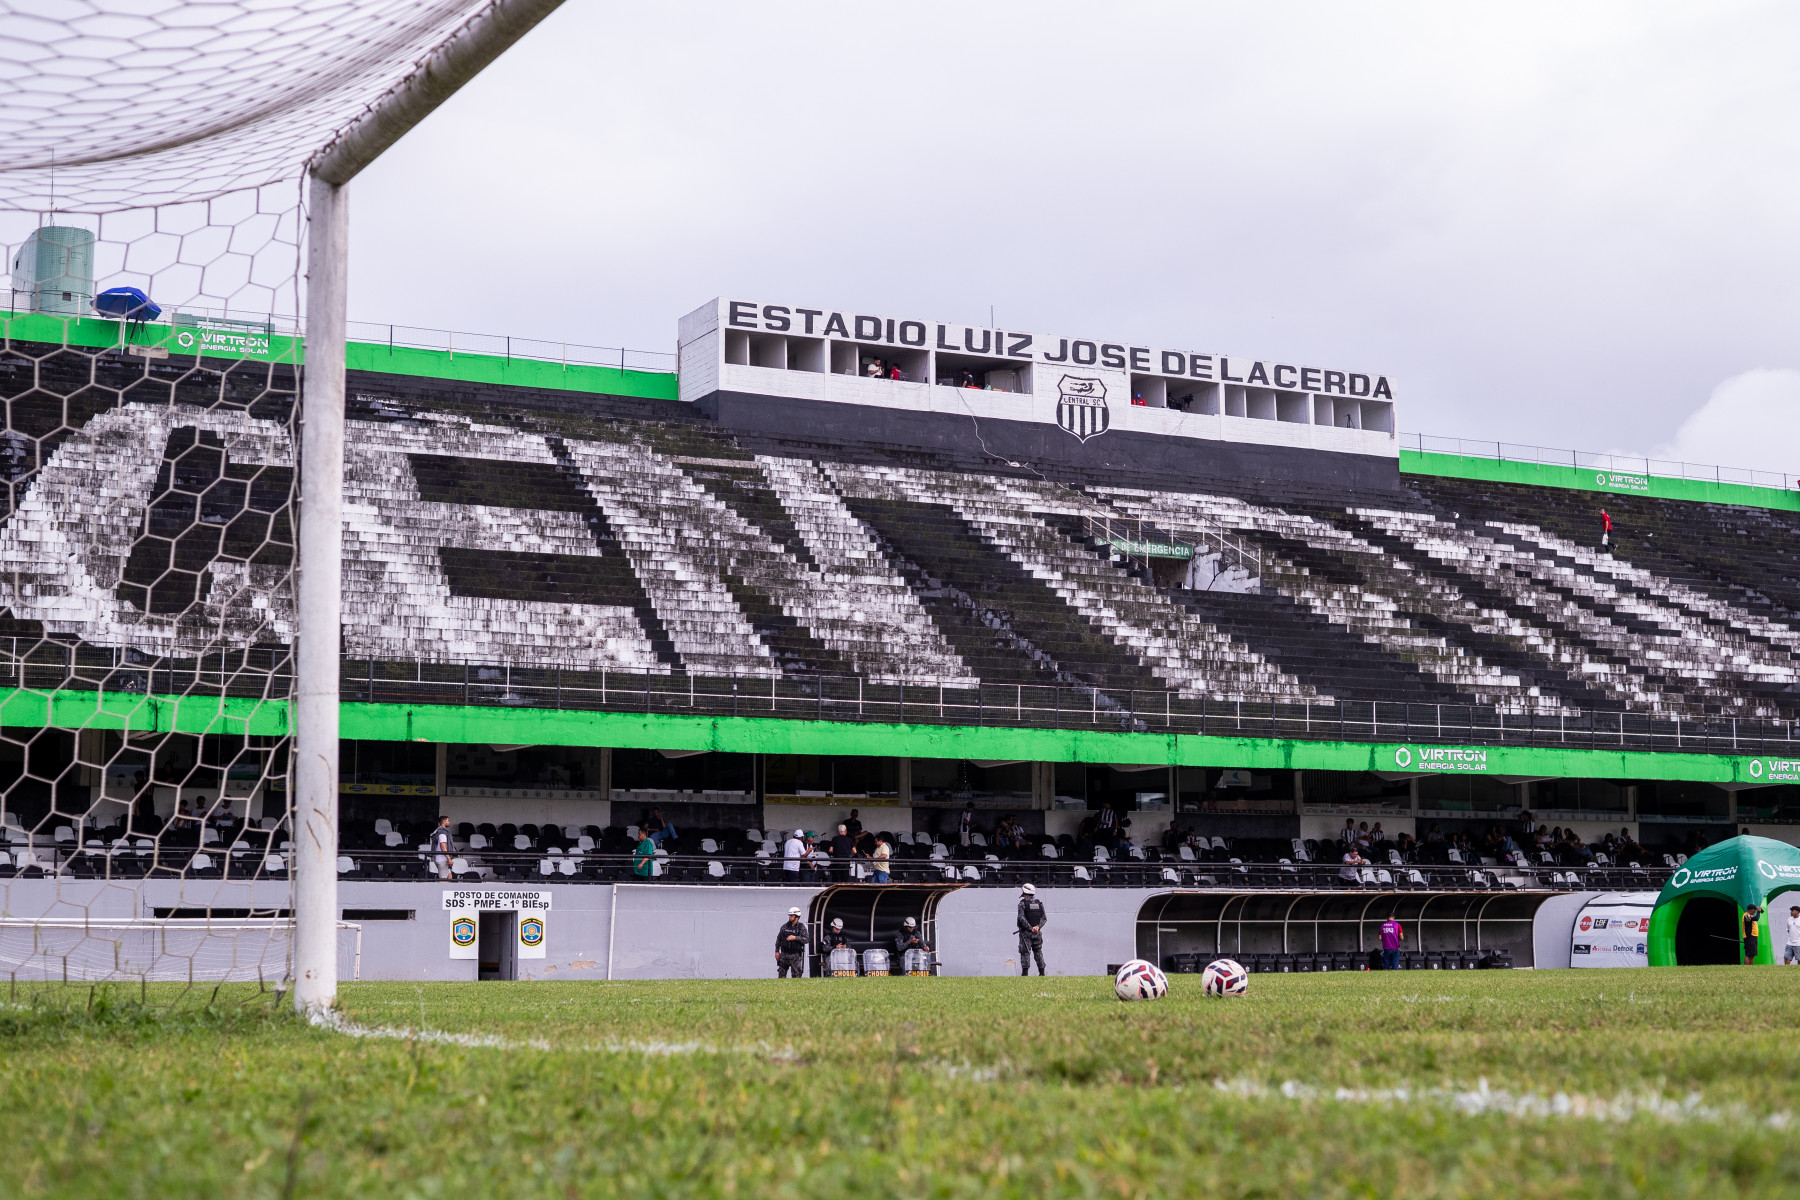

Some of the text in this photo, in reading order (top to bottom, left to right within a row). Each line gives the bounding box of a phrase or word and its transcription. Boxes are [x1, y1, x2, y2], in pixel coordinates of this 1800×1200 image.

[202, 332, 268, 347] VIRTRON
[729, 300, 1393, 400] ESTADIO LUIZ JOSE DE LACERDA
[1064, 396, 1101, 406] CENTRAL SC
[1608, 474, 1648, 485] VIRTRON
[1418, 748, 1487, 762] VIRTRON
[1418, 762, 1487, 771] ENERGIA SOLAR
[1768, 760, 1800, 772] VIRT
[1694, 866, 1738, 878] VIRTRON
[1773, 864, 1800, 873] VIRT
[1715, 875, 1735, 883] SOLAR
[453, 891, 482, 899] POSTO
[445, 899, 465, 908] SDS
[474, 900, 501, 908] PMPE
[522, 900, 549, 910] BIEsp
